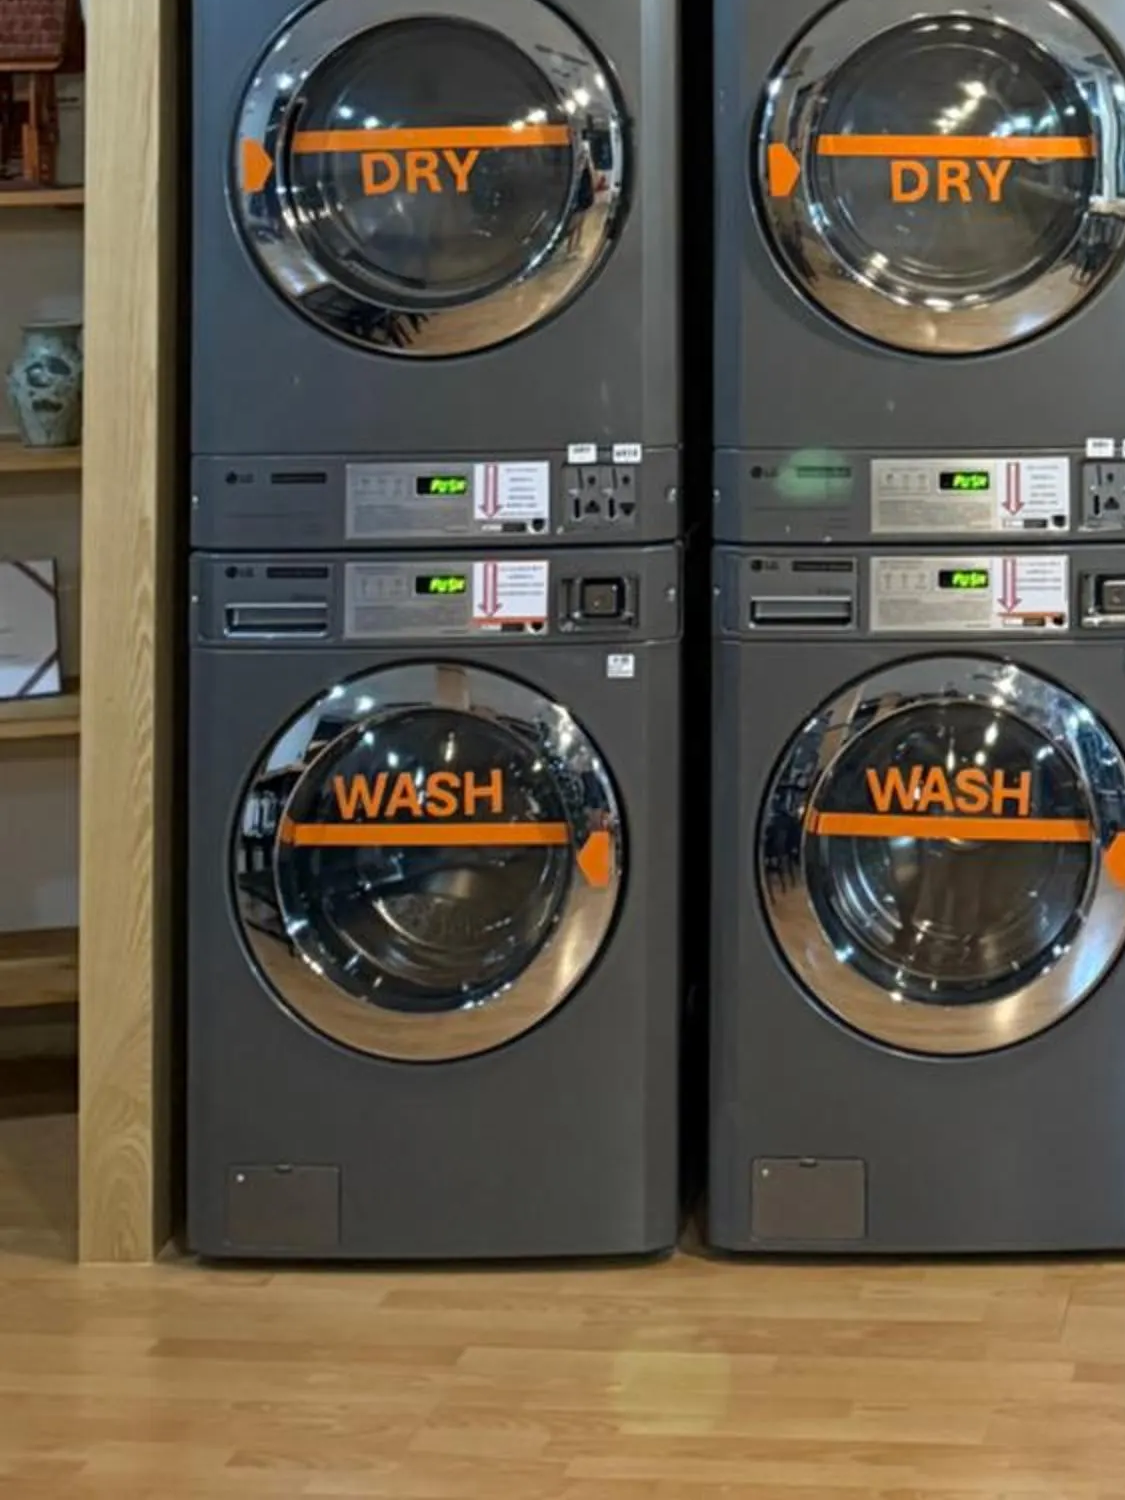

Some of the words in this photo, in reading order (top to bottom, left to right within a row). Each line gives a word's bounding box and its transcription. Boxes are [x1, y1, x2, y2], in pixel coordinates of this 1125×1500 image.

[361, 149, 480, 196] DRY
[889, 158, 1011, 204] DRY
[334, 770, 503, 818] WASH
[866, 766, 1031, 816] WASH
